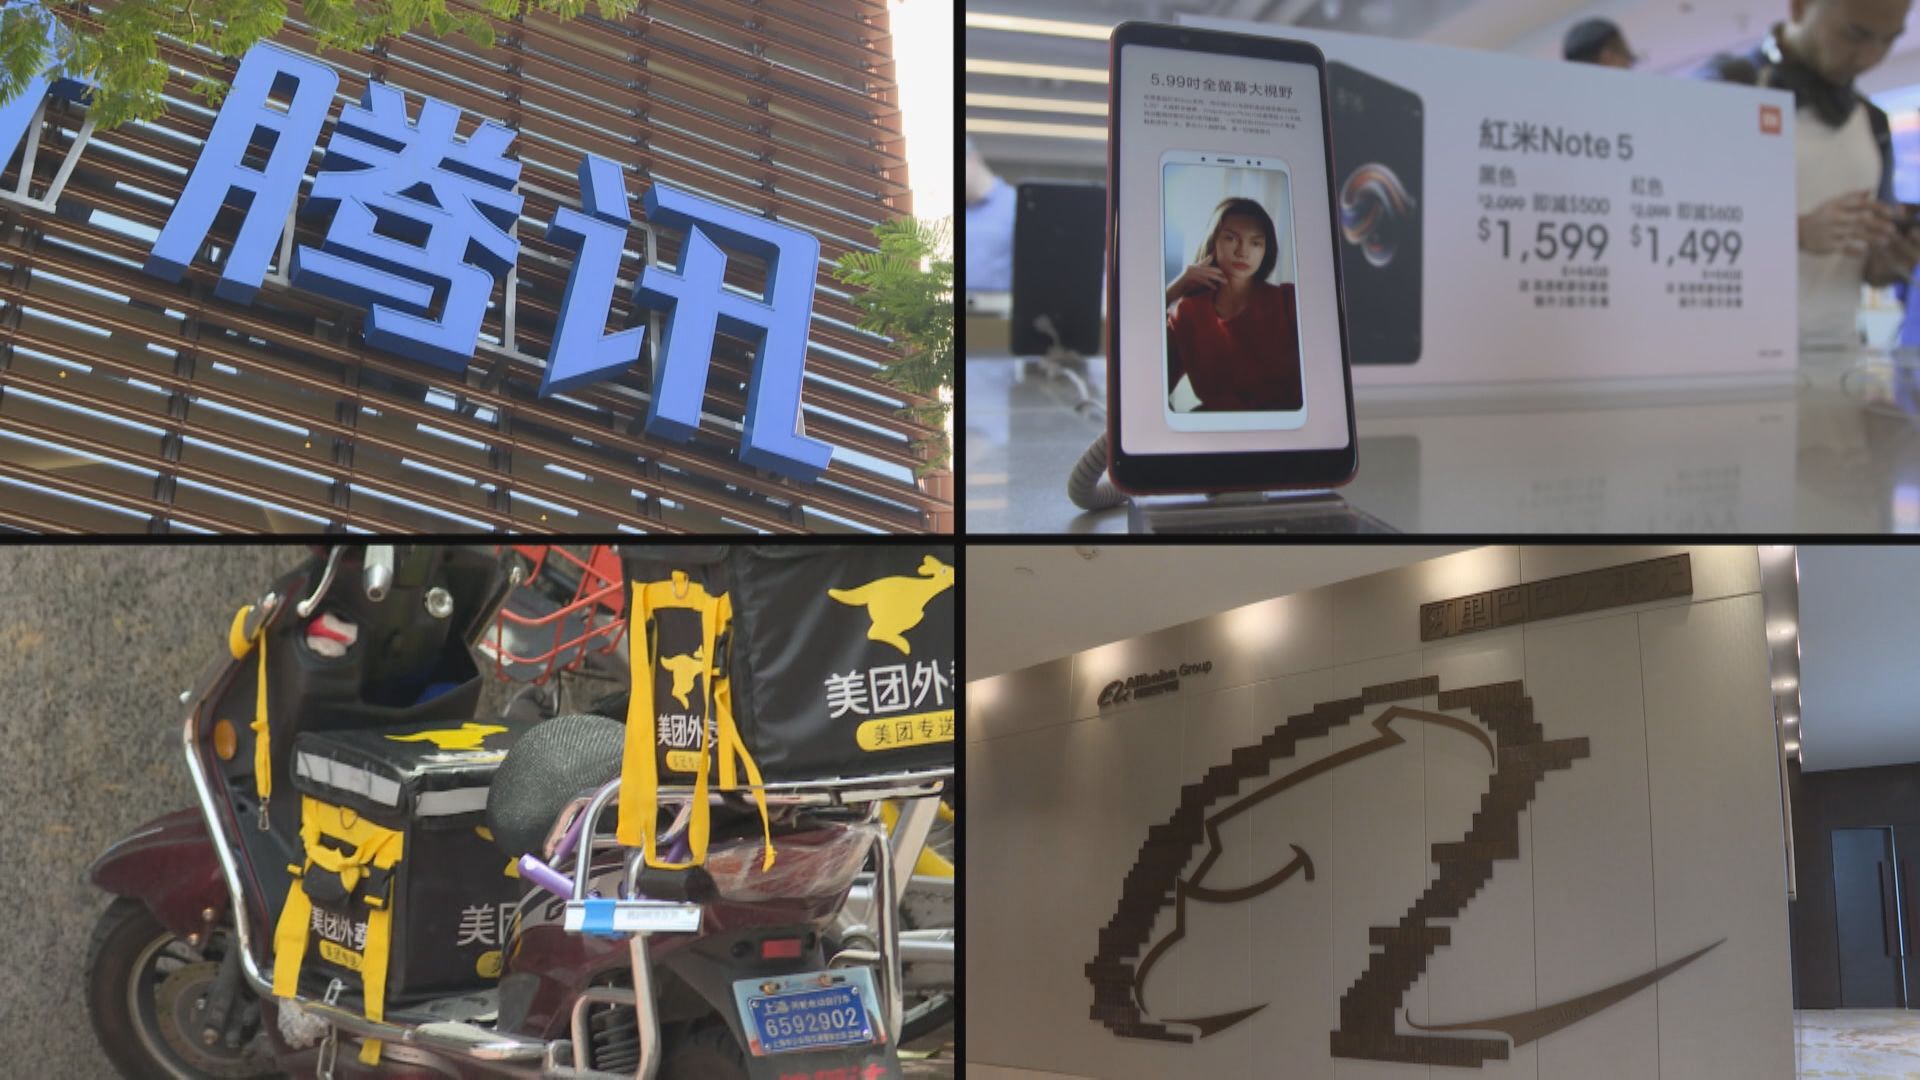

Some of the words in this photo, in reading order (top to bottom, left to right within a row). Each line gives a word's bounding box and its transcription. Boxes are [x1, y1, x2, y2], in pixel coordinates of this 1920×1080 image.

[1478, 117, 1612, 161] 紅米Note
[1616, 132, 1635, 161] 5
[144, 41, 834, 480] 腾讯
[1477, 215, 1609, 264] $1,599
[1629, 223, 1743, 268] $1,499
[824, 659, 954, 718] 美团外
[1179, 660, 1213, 676] Group
[764, 1007, 860, 1038] 6592902
